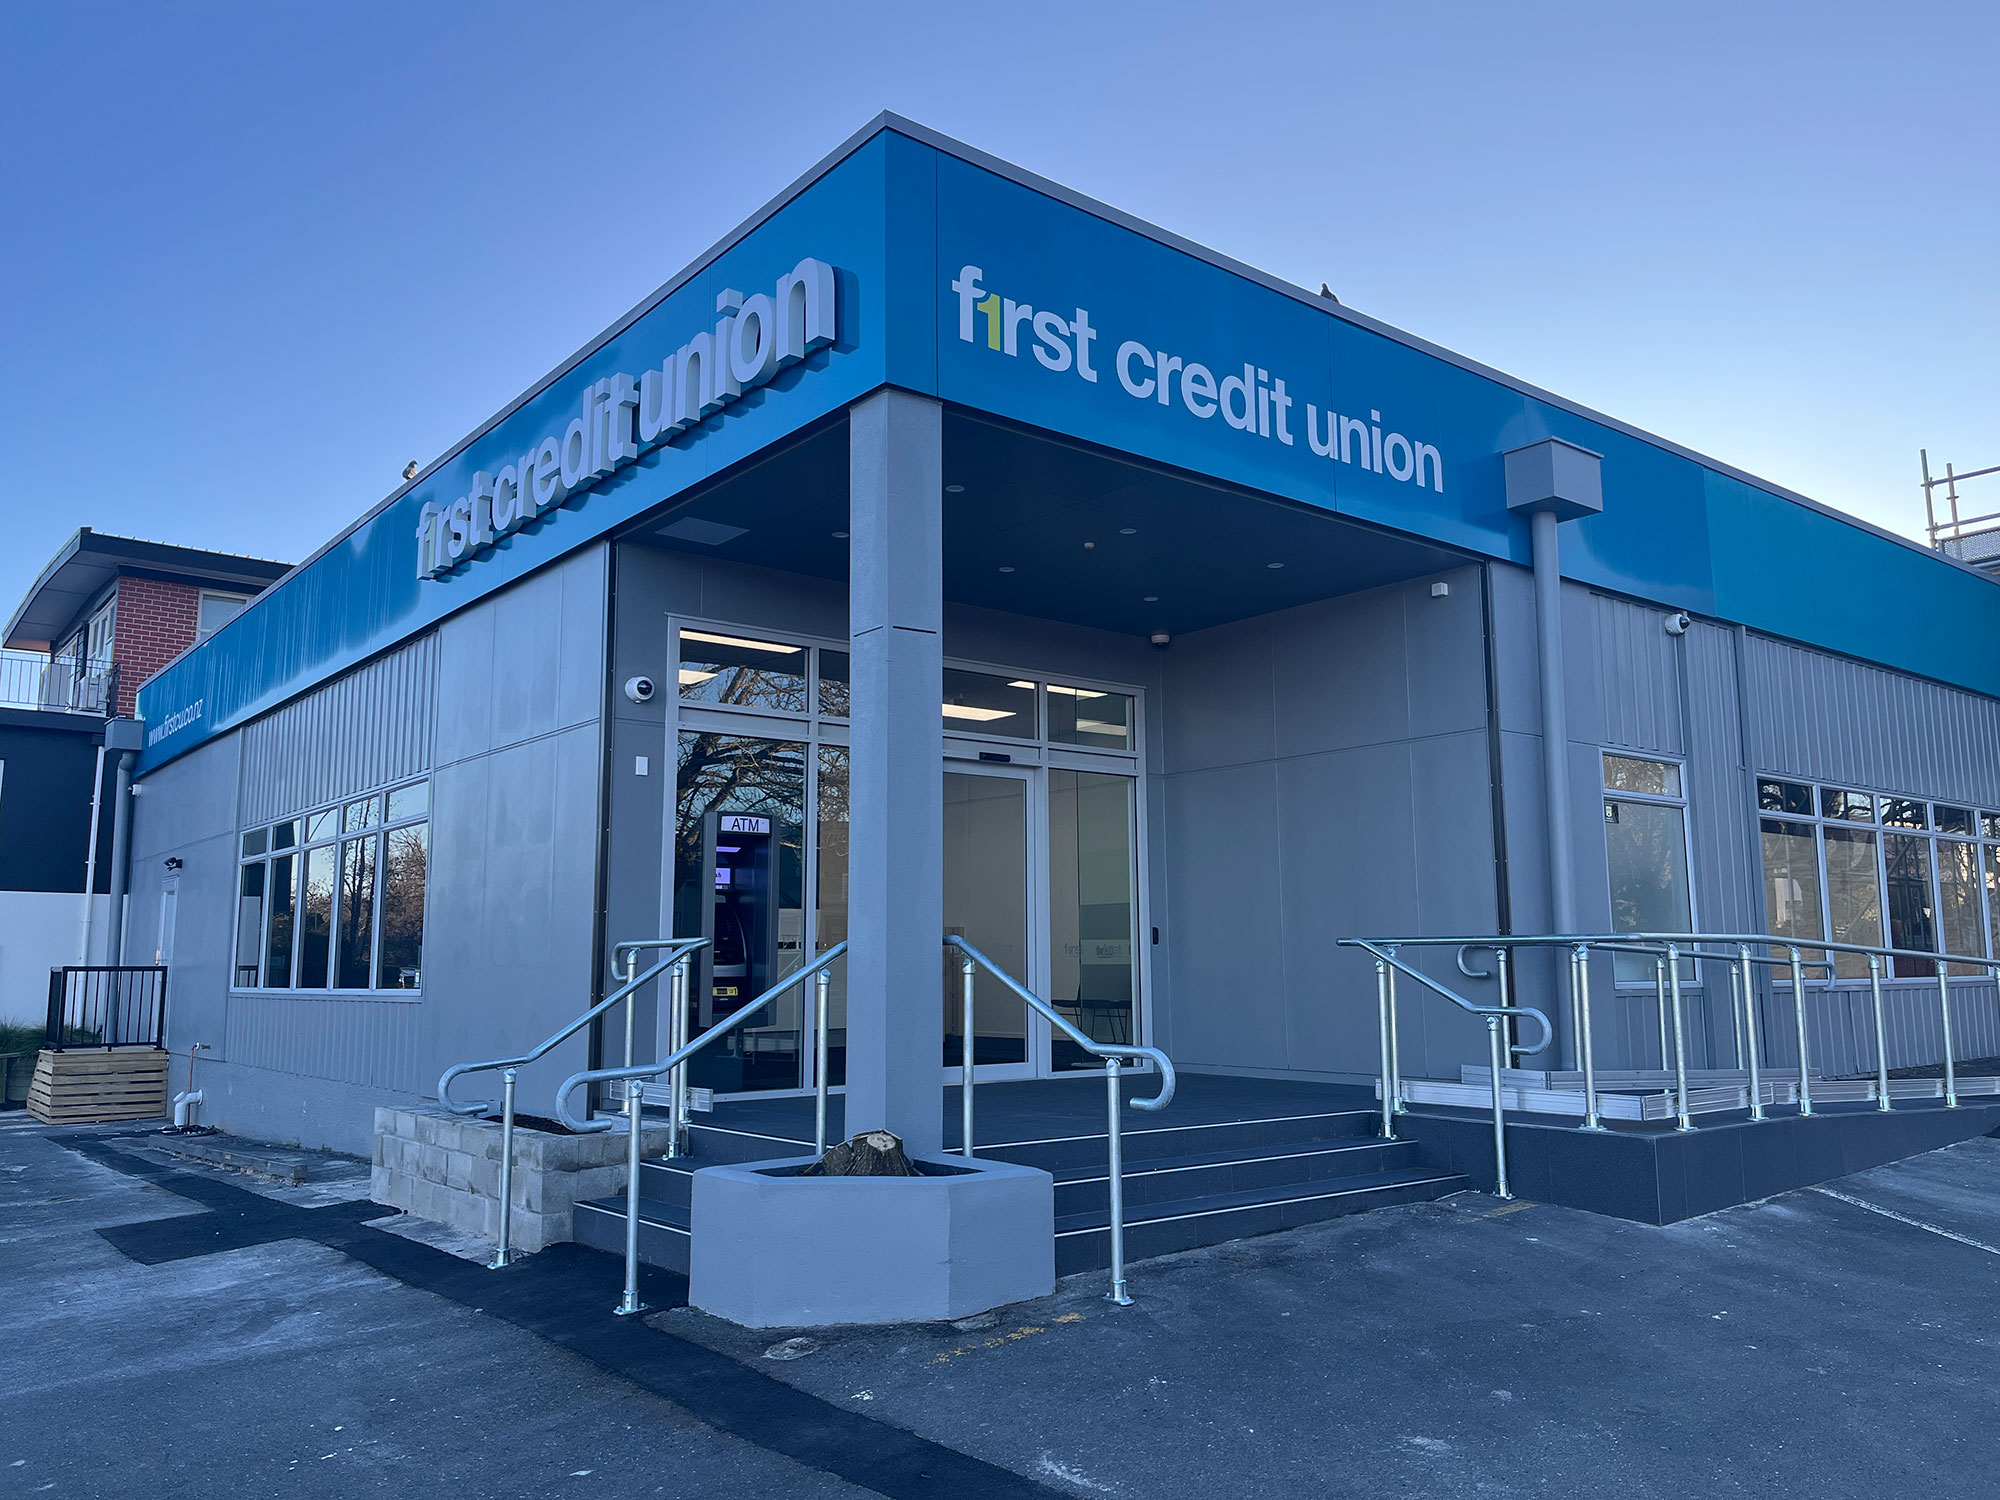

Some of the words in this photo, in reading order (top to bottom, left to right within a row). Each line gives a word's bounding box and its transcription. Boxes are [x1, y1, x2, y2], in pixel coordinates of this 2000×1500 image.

[492, 372, 639, 532] credit
[639, 257, 836, 443] union
[1116, 340, 1293, 446] credit
[1306, 404, 1444, 493] union
[731, 817, 760, 832] ATM
